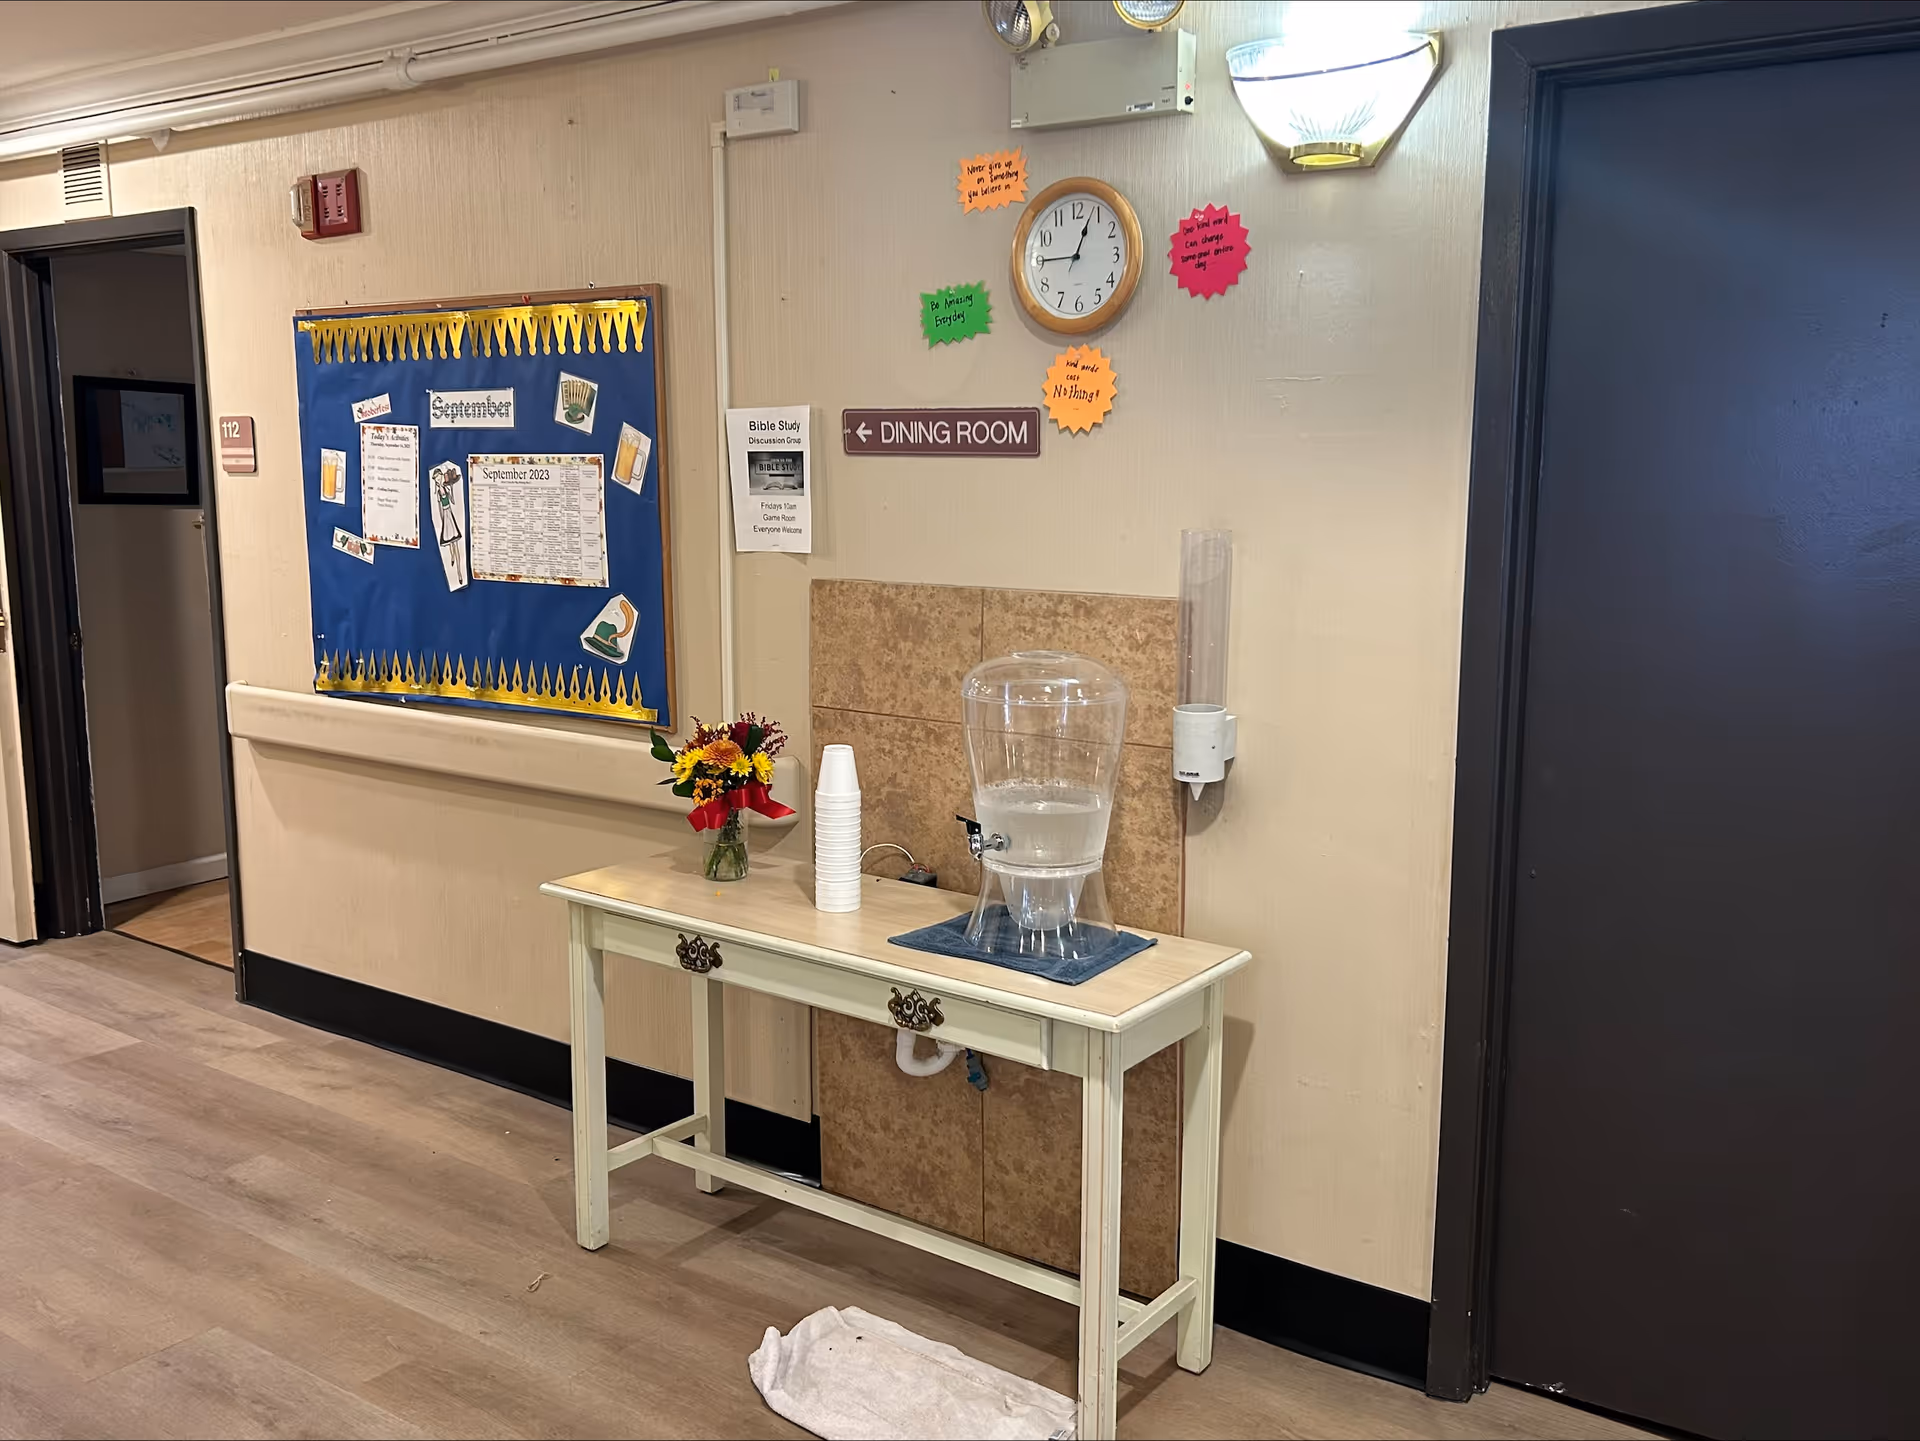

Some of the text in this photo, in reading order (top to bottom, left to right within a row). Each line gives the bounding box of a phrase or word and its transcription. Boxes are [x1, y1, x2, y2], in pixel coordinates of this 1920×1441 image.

[989, 162, 1001, 174] give
[1004, 160, 1012, 169] up
[968, 190, 978, 203] you
[981, 184, 1001, 196] believe
[1054, 209, 1063, 227] 11
[1072, 201, 1084, 220] 12
[1097, 205, 1100, 223] 1
[1040, 229, 1052, 247] 10
[1108, 221, 1116, 239] 2
[1036, 255, 1045, 271] 9
[1113, 246, 1120, 263] 3
[1040, 277, 1050, 293] 8
[1106, 271, 1115, 288] 4
[930, 293, 974, 312] Be Amazing
[1057, 291, 1065, 308] 7
[1074, 295, 1084, 312] 6
[1094, 288, 1102, 305] 5
[935, 310, 966, 328] Everyday
[1053, 384, 1100, 403] Nothing!
[432, 395, 512, 423] September
[221, 421, 240, 438] 112
[749, 420, 801, 432] Bible Study
[880, 420, 1028, 444] DINING ROOM
[748, 436, 802, 445] Discussion Group
[483, 467, 527, 482] September
[529, 468, 550, 480] 2023
[759, 463, 780, 471] BIBLE
[761, 502, 782, 511] Fridays
[781, 514, 796, 522] Room
[753, 525, 802, 534] Everyone Welcome
